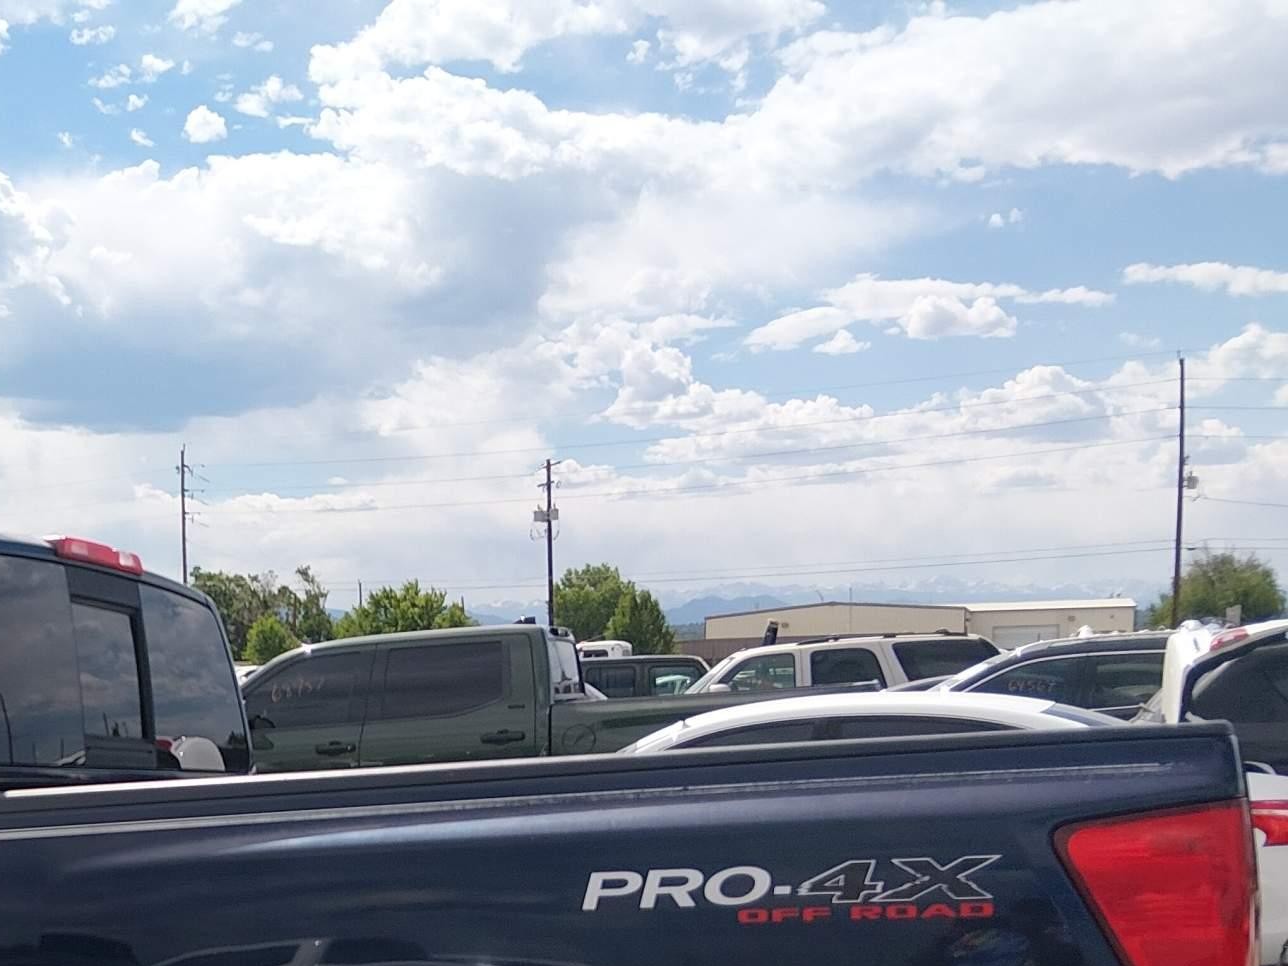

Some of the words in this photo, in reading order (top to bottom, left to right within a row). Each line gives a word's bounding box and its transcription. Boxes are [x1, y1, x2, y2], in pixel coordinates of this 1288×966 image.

[581, 854, 1003, 912] PRO-4X
[737, 905, 833, 924] OFF
[850, 901, 995, 921] ROAD
